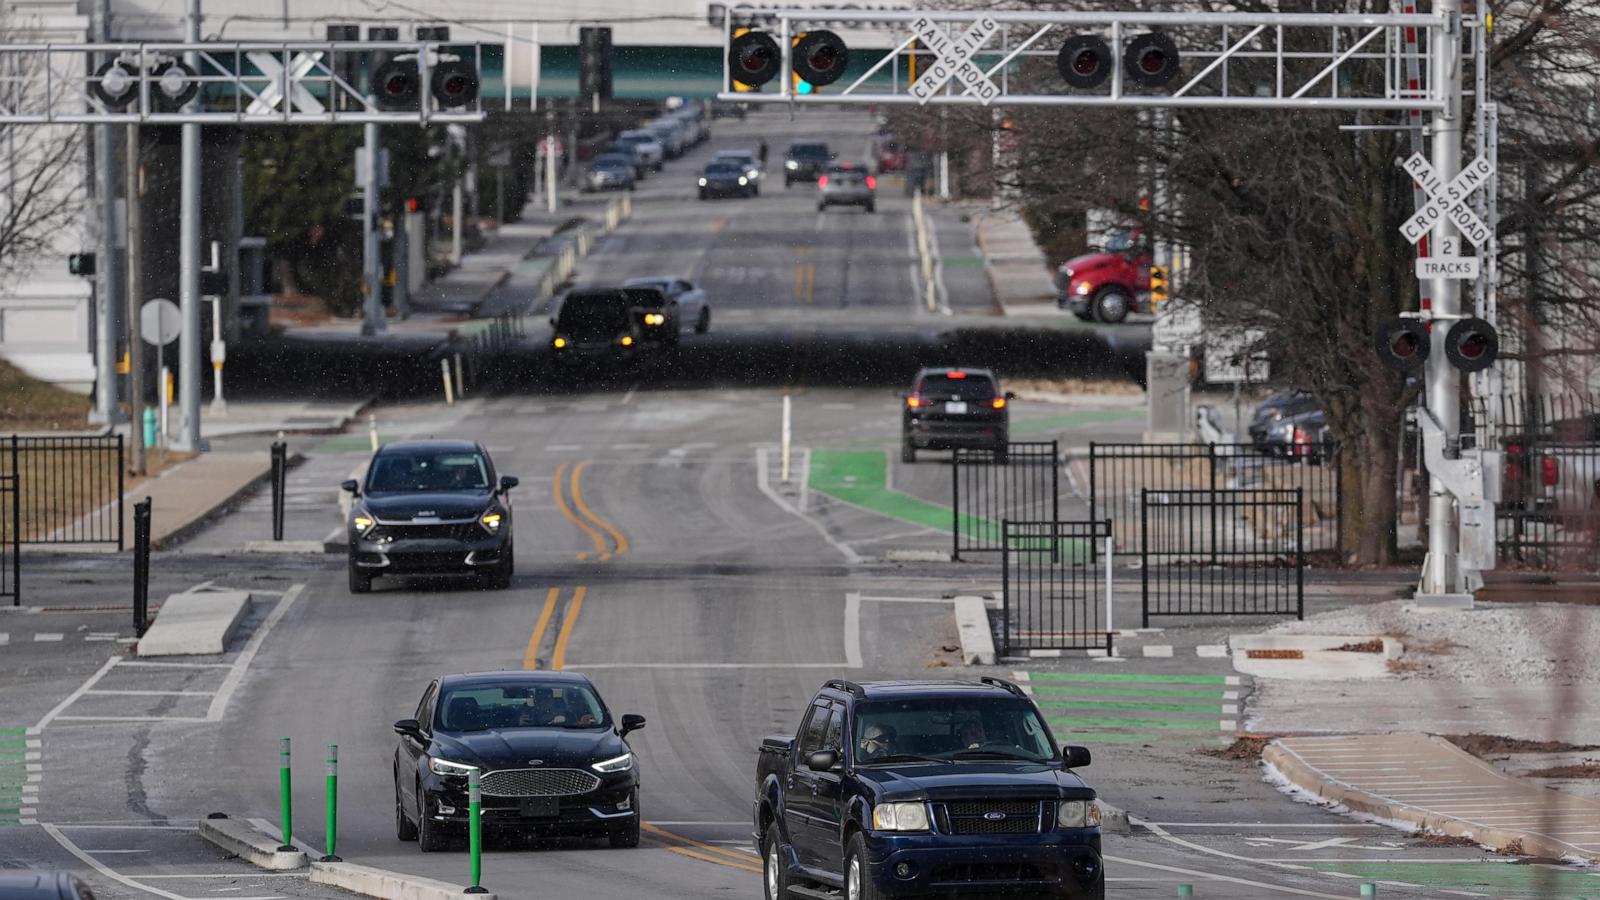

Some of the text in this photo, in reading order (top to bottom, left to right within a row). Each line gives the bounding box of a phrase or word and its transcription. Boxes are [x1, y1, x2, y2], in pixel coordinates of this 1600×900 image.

[914, 18, 995, 99] CROSSING
[1406, 161, 1489, 238] CROSSING
[1425, 263, 1471, 274] TRACKS
[1443, 240, 1452, 255] 2
